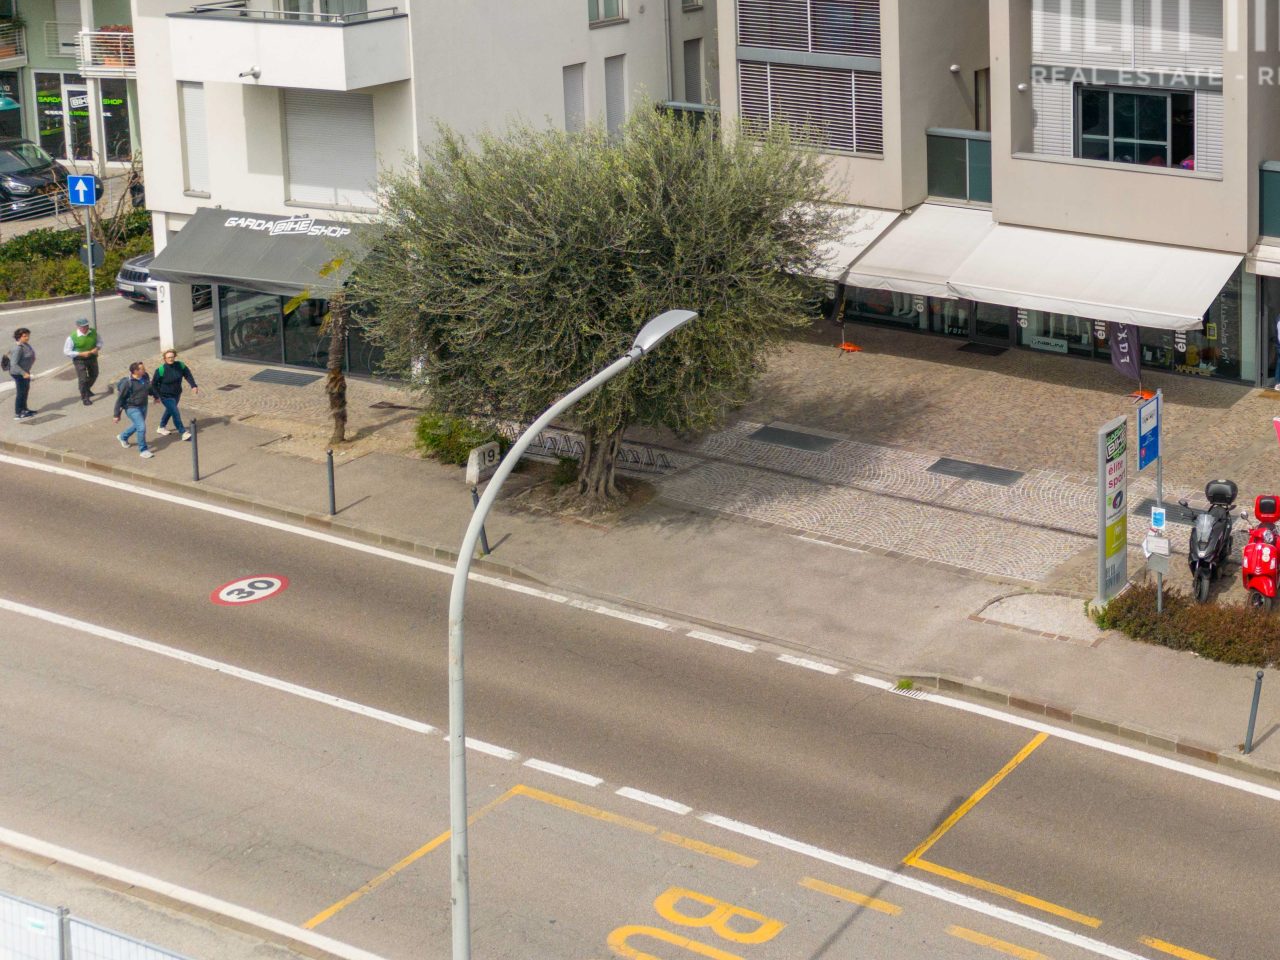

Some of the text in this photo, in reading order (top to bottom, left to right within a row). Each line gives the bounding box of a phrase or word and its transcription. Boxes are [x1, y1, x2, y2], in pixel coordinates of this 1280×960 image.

[72, 96, 88, 106] BIK
[224, 217, 351, 237] GARDA BIKE SHOP
[482, 449, 495, 465] 19
[226, 580, 275, 599] 30
